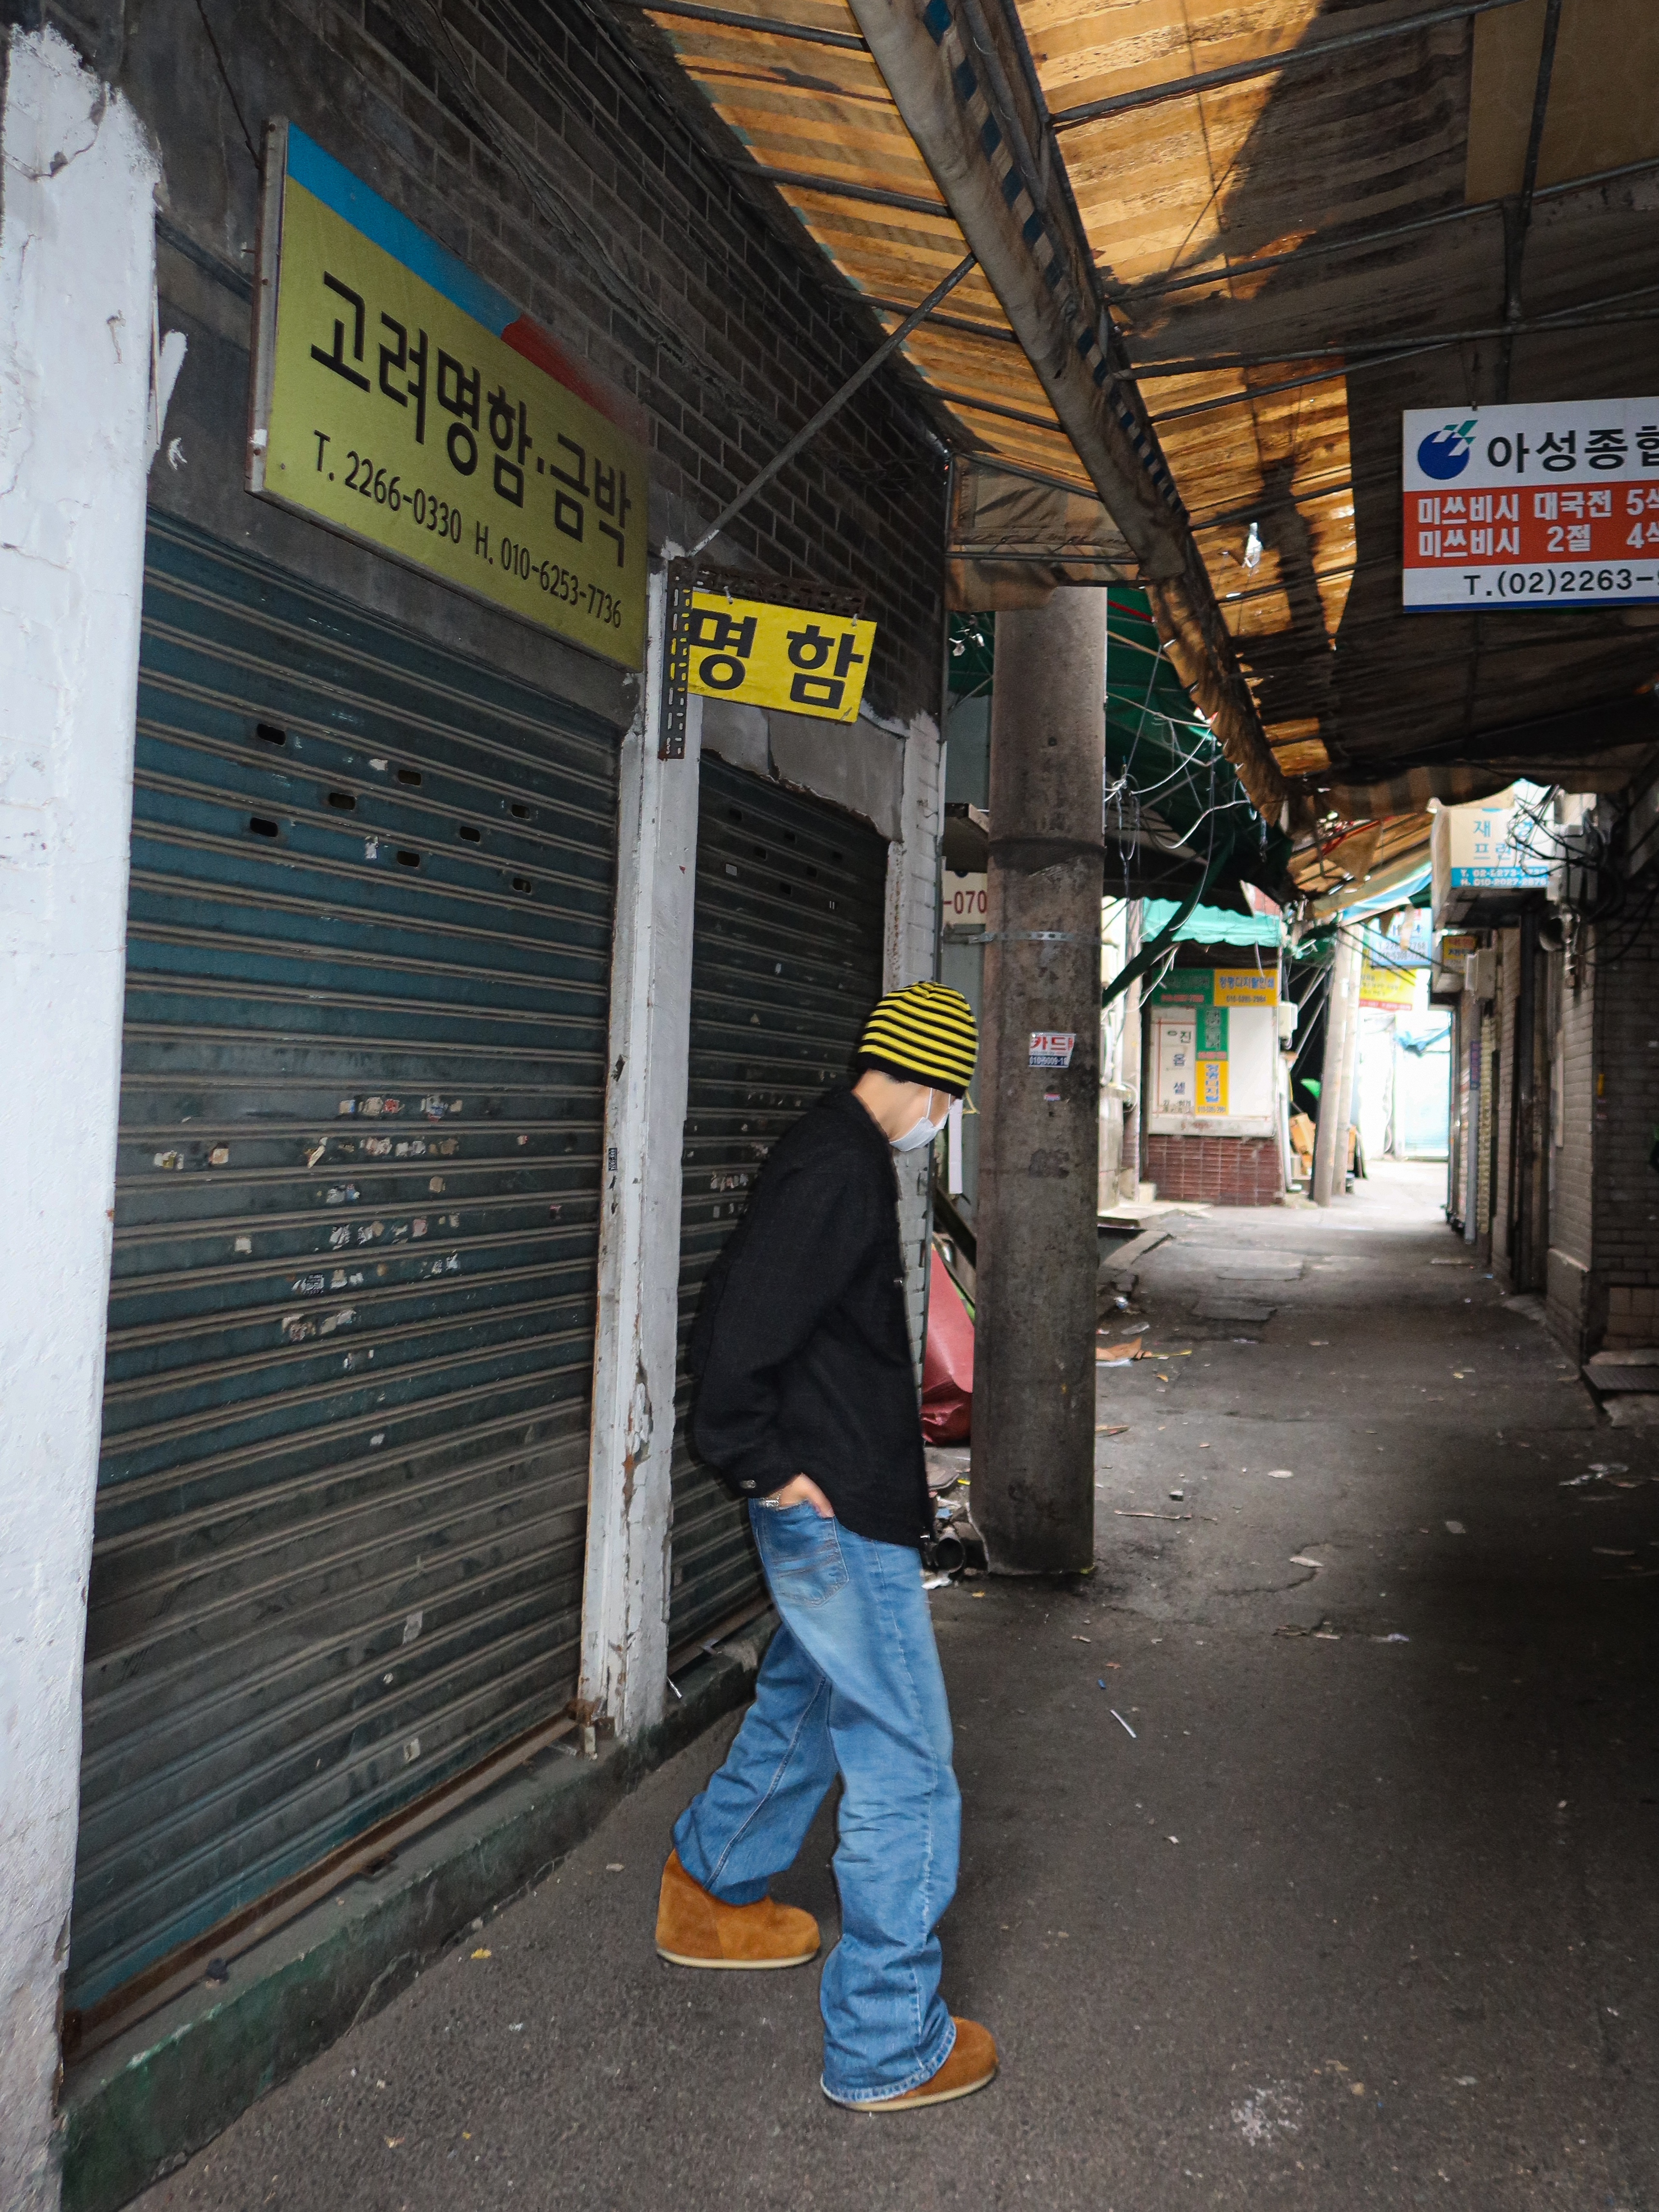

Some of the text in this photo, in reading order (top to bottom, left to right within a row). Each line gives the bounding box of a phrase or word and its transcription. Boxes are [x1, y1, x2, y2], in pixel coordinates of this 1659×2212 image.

[1418, 493, 1520, 525] 미쓰비시
[1534, 489, 1612, 521] 대국전
[313, 429, 621, 629] T. 2266-0330 H. 010-6253-7736
[1418, 526, 1520, 558] 미쓰비시
[1547, 524, 1591, 553] 2절
[1464, 568, 1659, 597] T.(02)2263-
